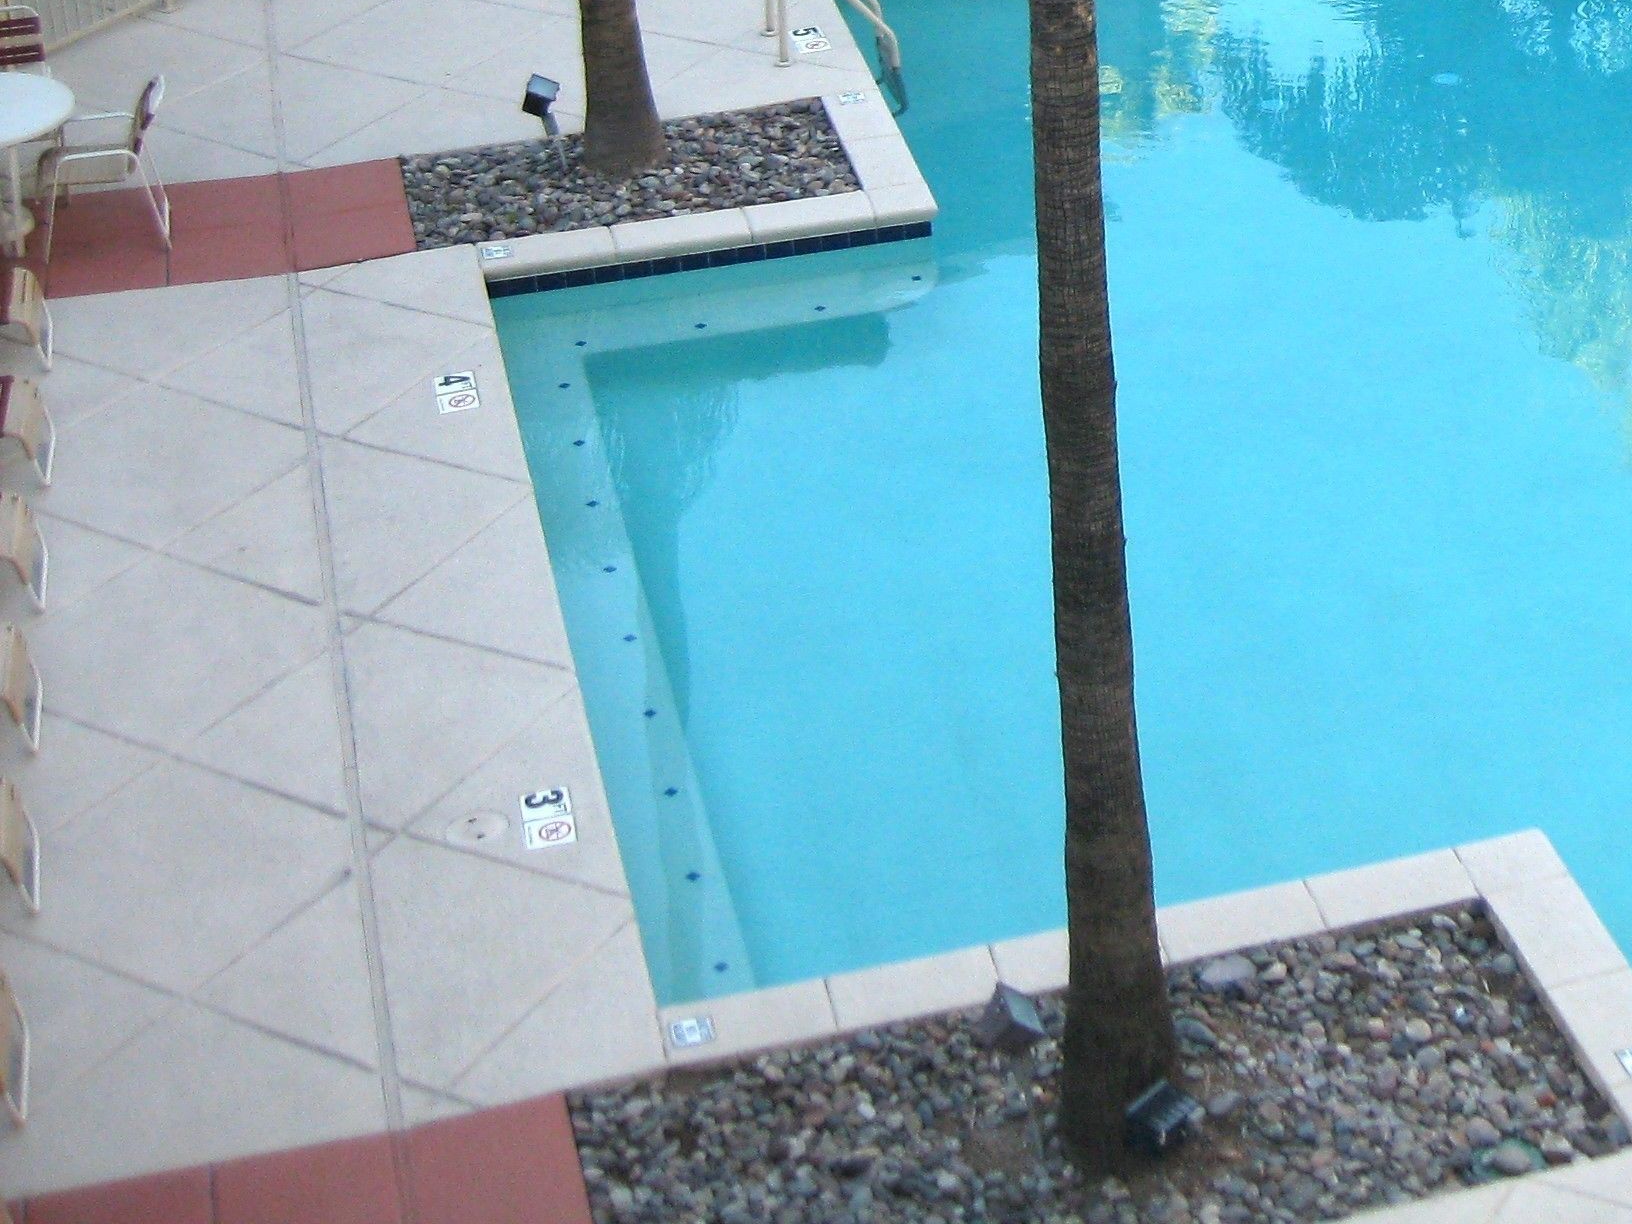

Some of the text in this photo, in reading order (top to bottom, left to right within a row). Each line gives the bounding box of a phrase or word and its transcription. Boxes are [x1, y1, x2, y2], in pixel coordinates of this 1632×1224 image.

[792, 27, 818, 37] 5
[438, 375, 470, 387] 4
[524, 789, 564, 809] 3
